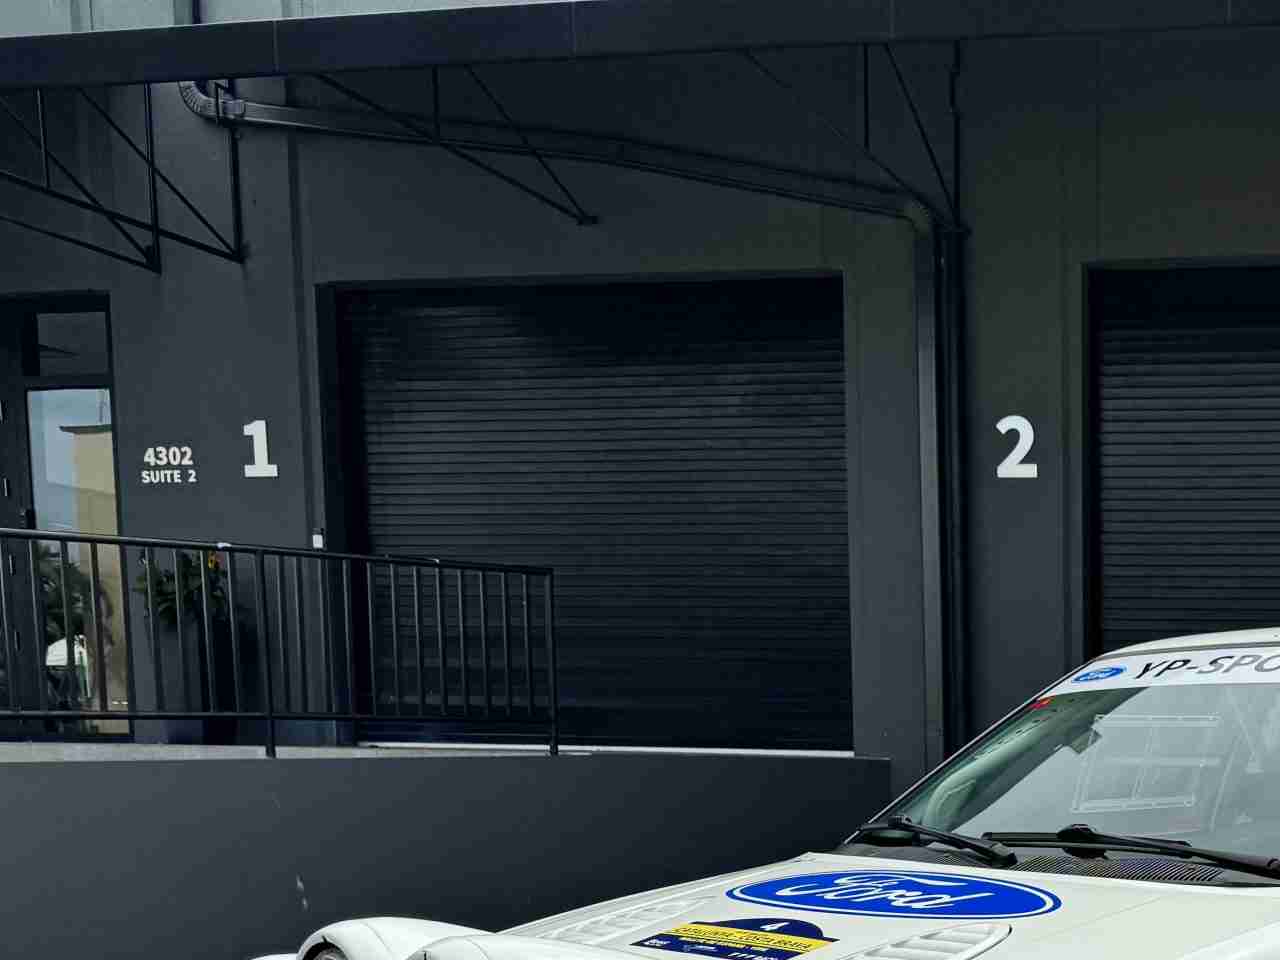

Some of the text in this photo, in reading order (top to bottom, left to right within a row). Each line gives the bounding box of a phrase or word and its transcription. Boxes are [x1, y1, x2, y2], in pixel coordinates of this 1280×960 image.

[144, 446, 193, 466] 4302
[243, 420, 278, 477] 1
[996, 415, 1038, 478] 2
[141, 469, 197, 483] SUITE 2
[776, 873, 996, 909] Ford
